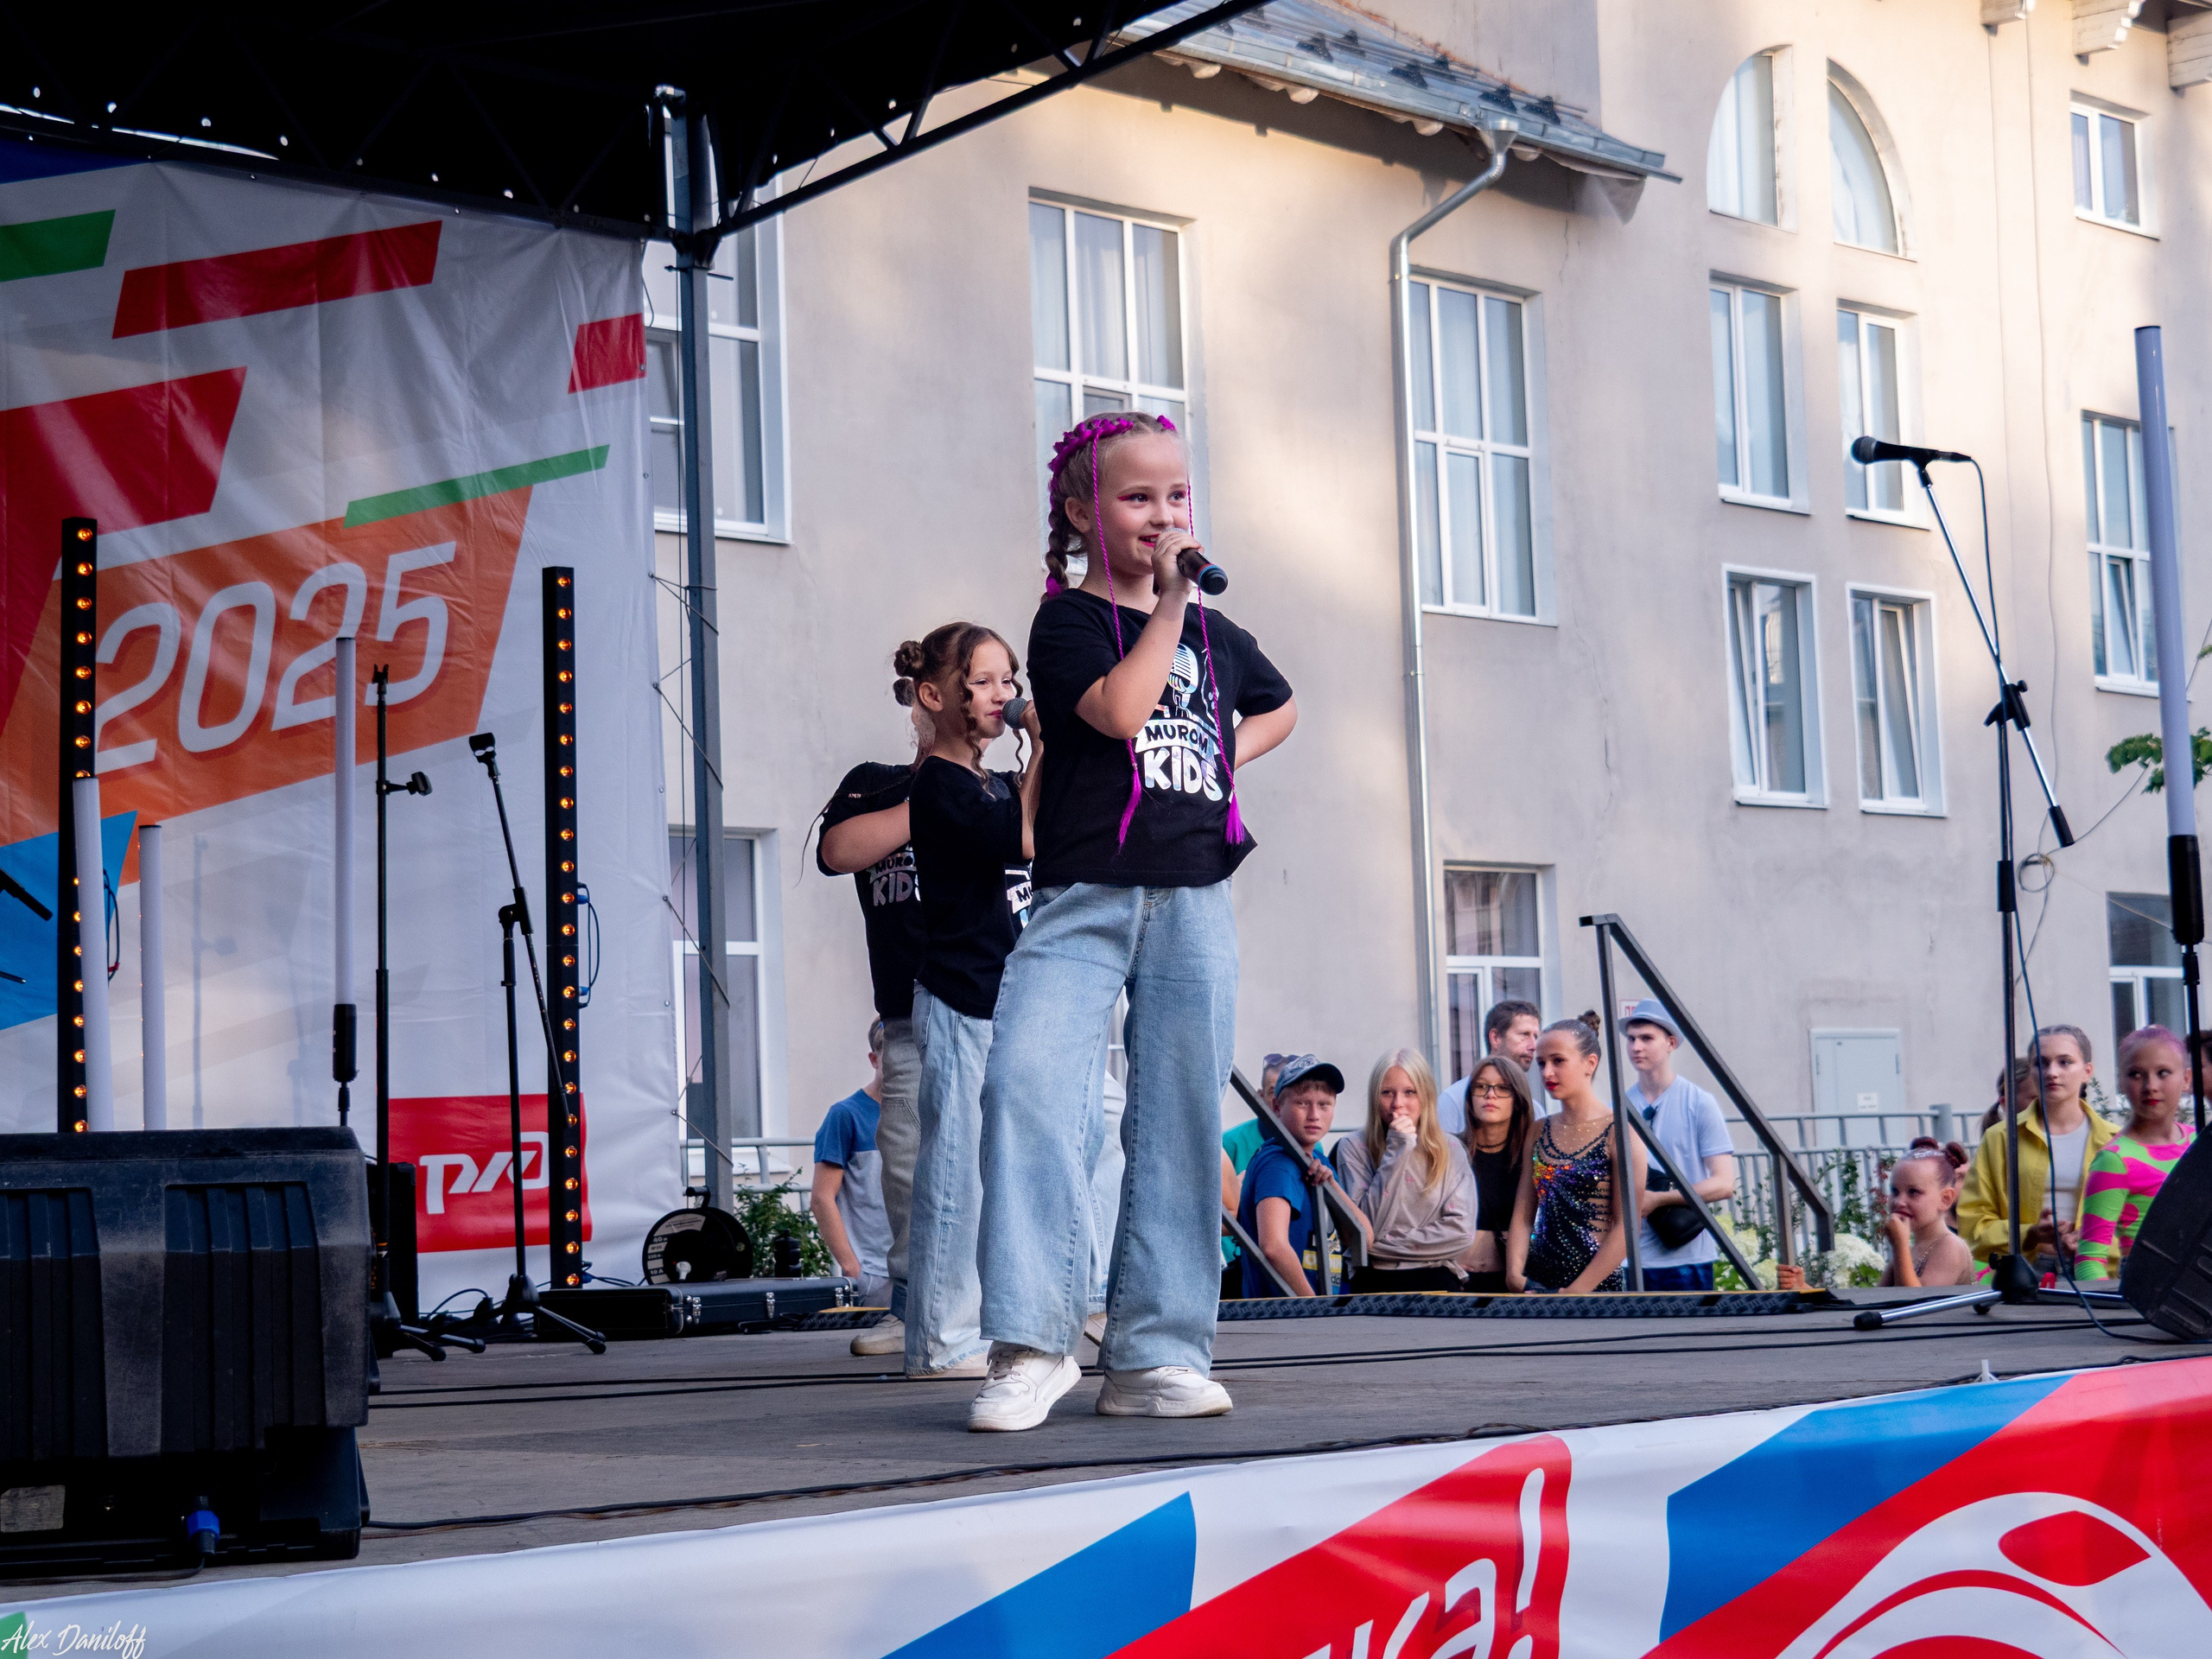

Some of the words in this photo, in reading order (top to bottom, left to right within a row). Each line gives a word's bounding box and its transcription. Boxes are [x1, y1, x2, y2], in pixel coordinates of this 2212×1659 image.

[95, 541, 456, 774] 2025
[1144, 724, 1208, 754] MUROM
[1144, 747, 1224, 801] KIDS
[875, 855, 914, 874] MURO
[873, 871, 921, 906] KID
